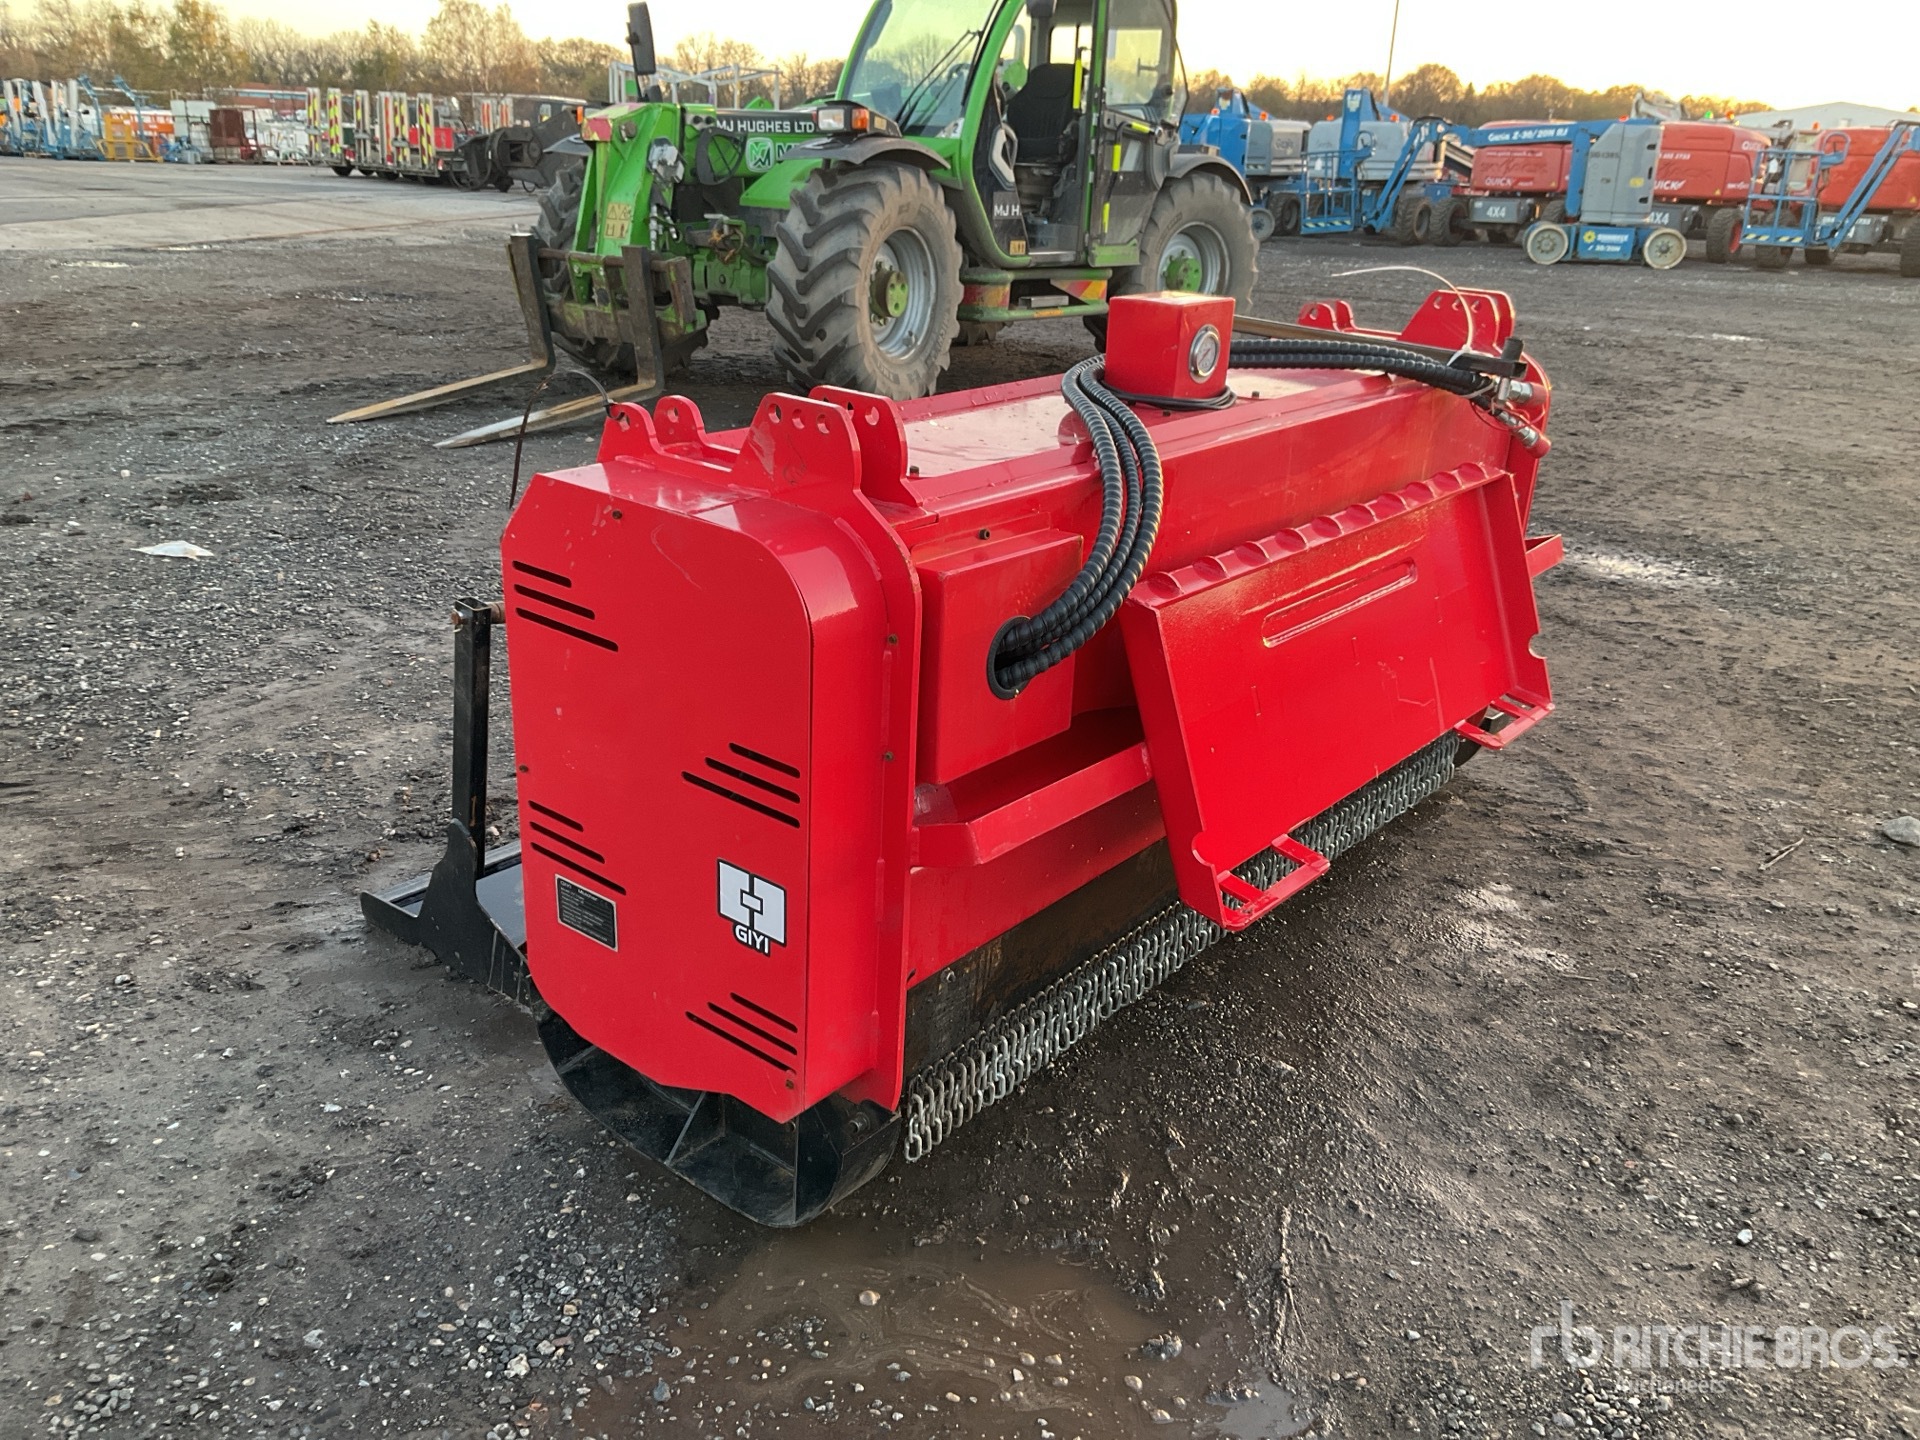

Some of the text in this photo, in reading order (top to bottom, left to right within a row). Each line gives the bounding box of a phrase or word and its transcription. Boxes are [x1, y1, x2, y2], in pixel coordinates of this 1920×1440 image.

[716, 120, 815, 133] MJ HUGHES LTD
[1484, 176, 1512, 186] QUICK
[1653, 180, 1680, 190] UICK
[993, 204, 1010, 217] MJ
[1486, 205, 1507, 218] 4X4
[734, 924, 769, 954] GIYI
